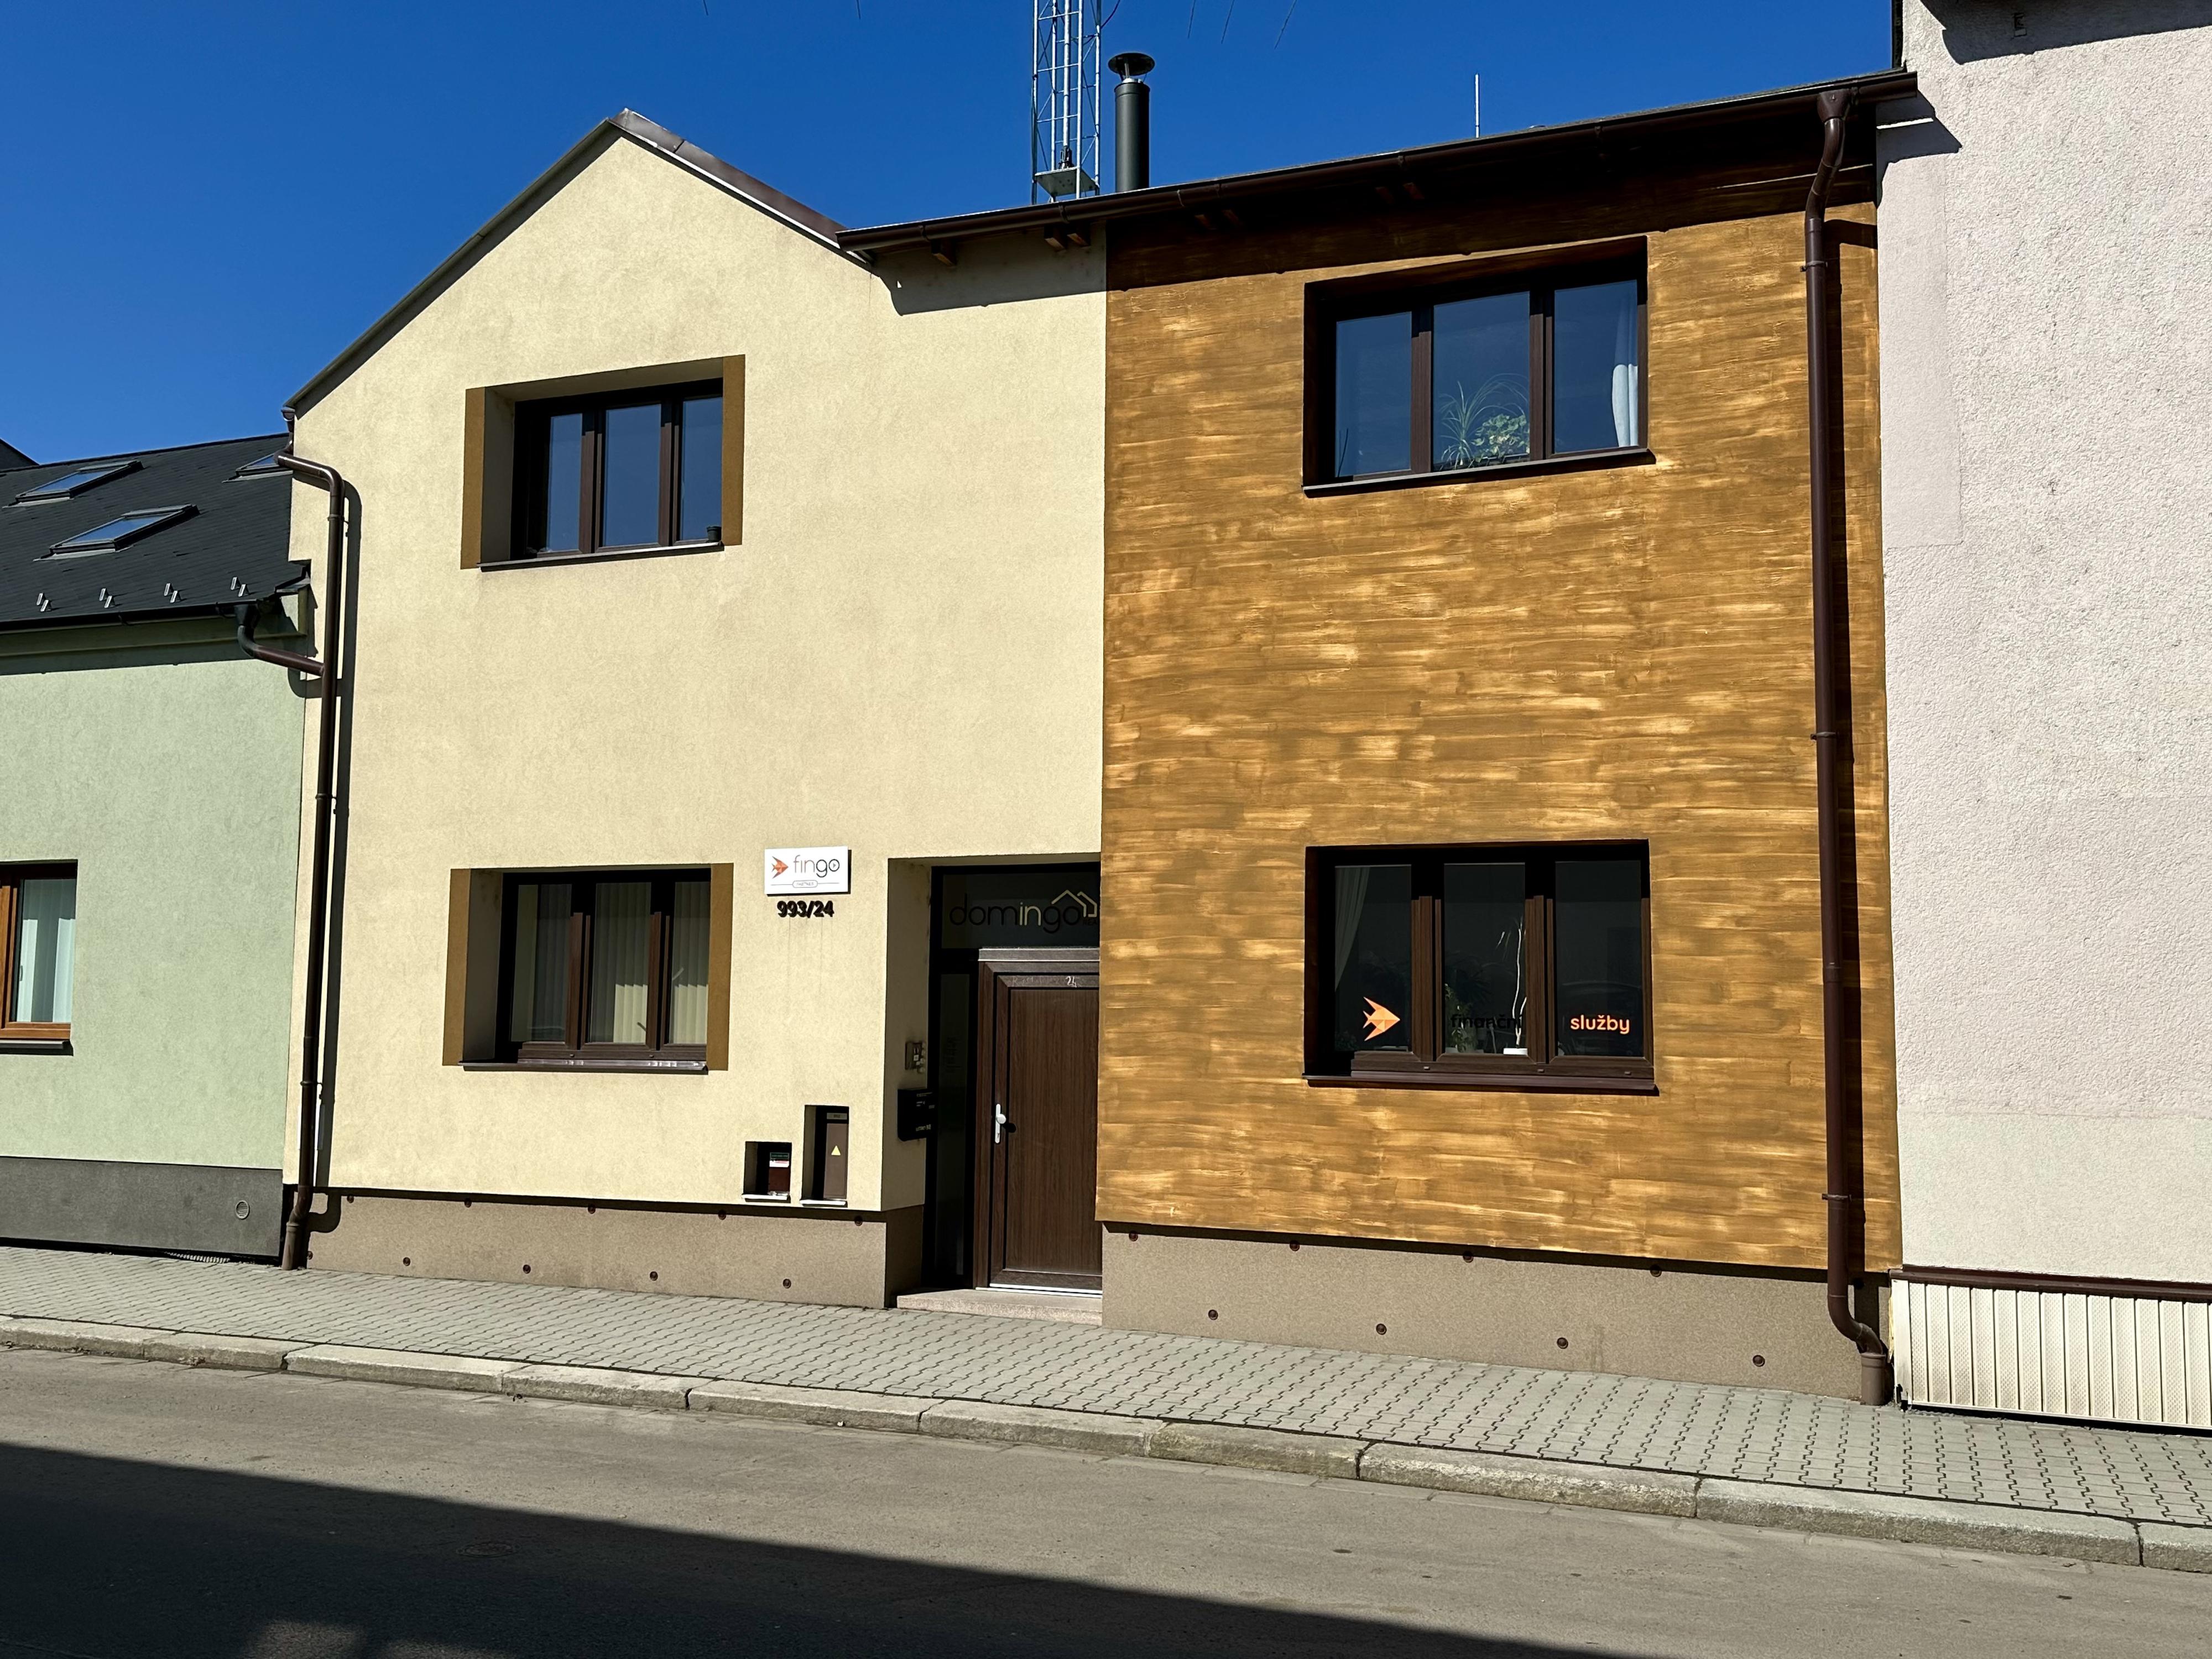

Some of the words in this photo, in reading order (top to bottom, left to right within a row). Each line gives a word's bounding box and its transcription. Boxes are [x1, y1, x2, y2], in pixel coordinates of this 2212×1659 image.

[793, 854, 840, 878] fingo
[777, 900, 834, 918] 993/24
[950, 893, 1081, 933] domingo
[1570, 1014, 1630, 1034] služby
